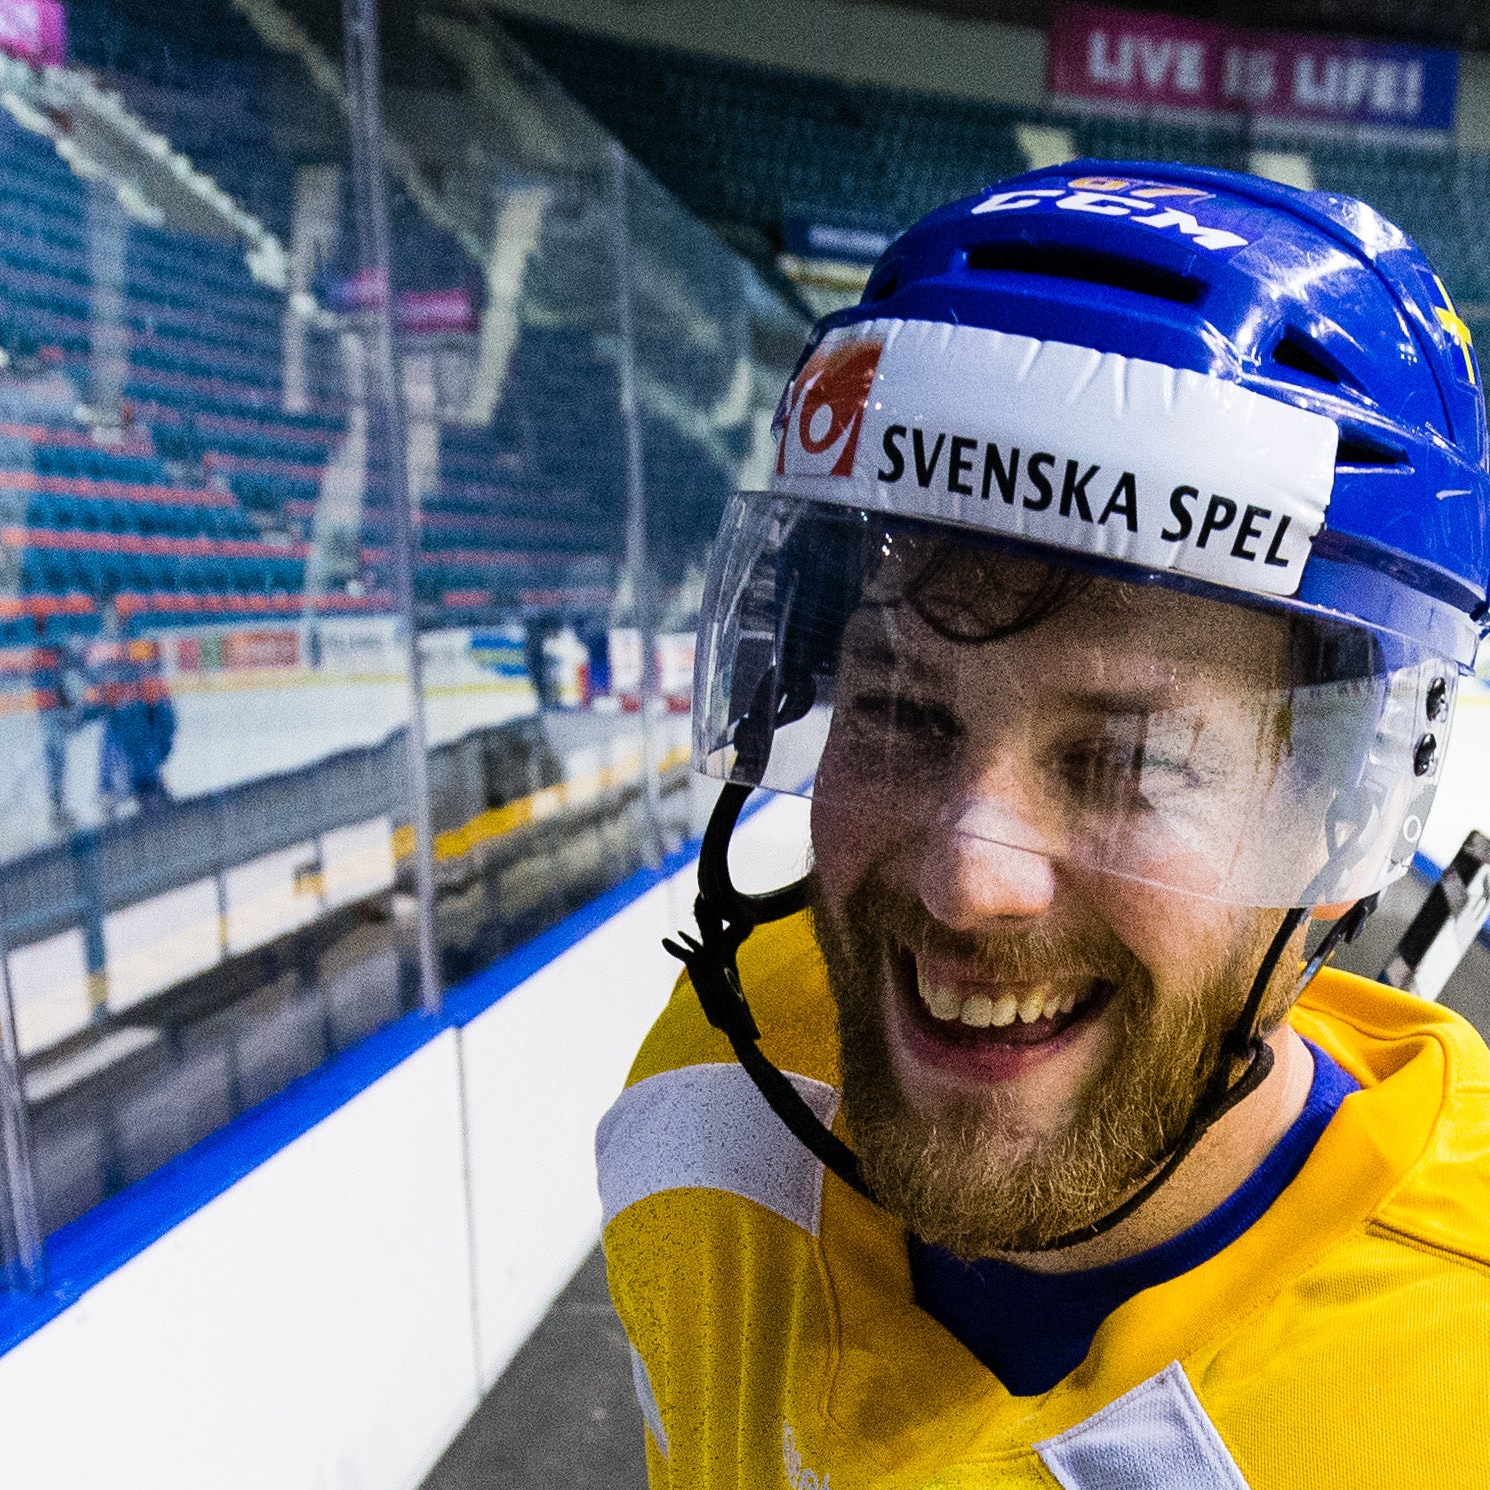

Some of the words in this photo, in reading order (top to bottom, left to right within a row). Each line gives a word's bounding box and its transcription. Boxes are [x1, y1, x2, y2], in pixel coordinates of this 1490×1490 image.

[1087, 33, 1203, 93] LIVE
[1223, 48, 1275, 98] IS
[1294, 55, 1425, 114] LIFE!
[971, 189, 1249, 251] CCM
[877, 424, 1139, 533] SVENSKA
[1161, 484, 1291, 568] SPEL
